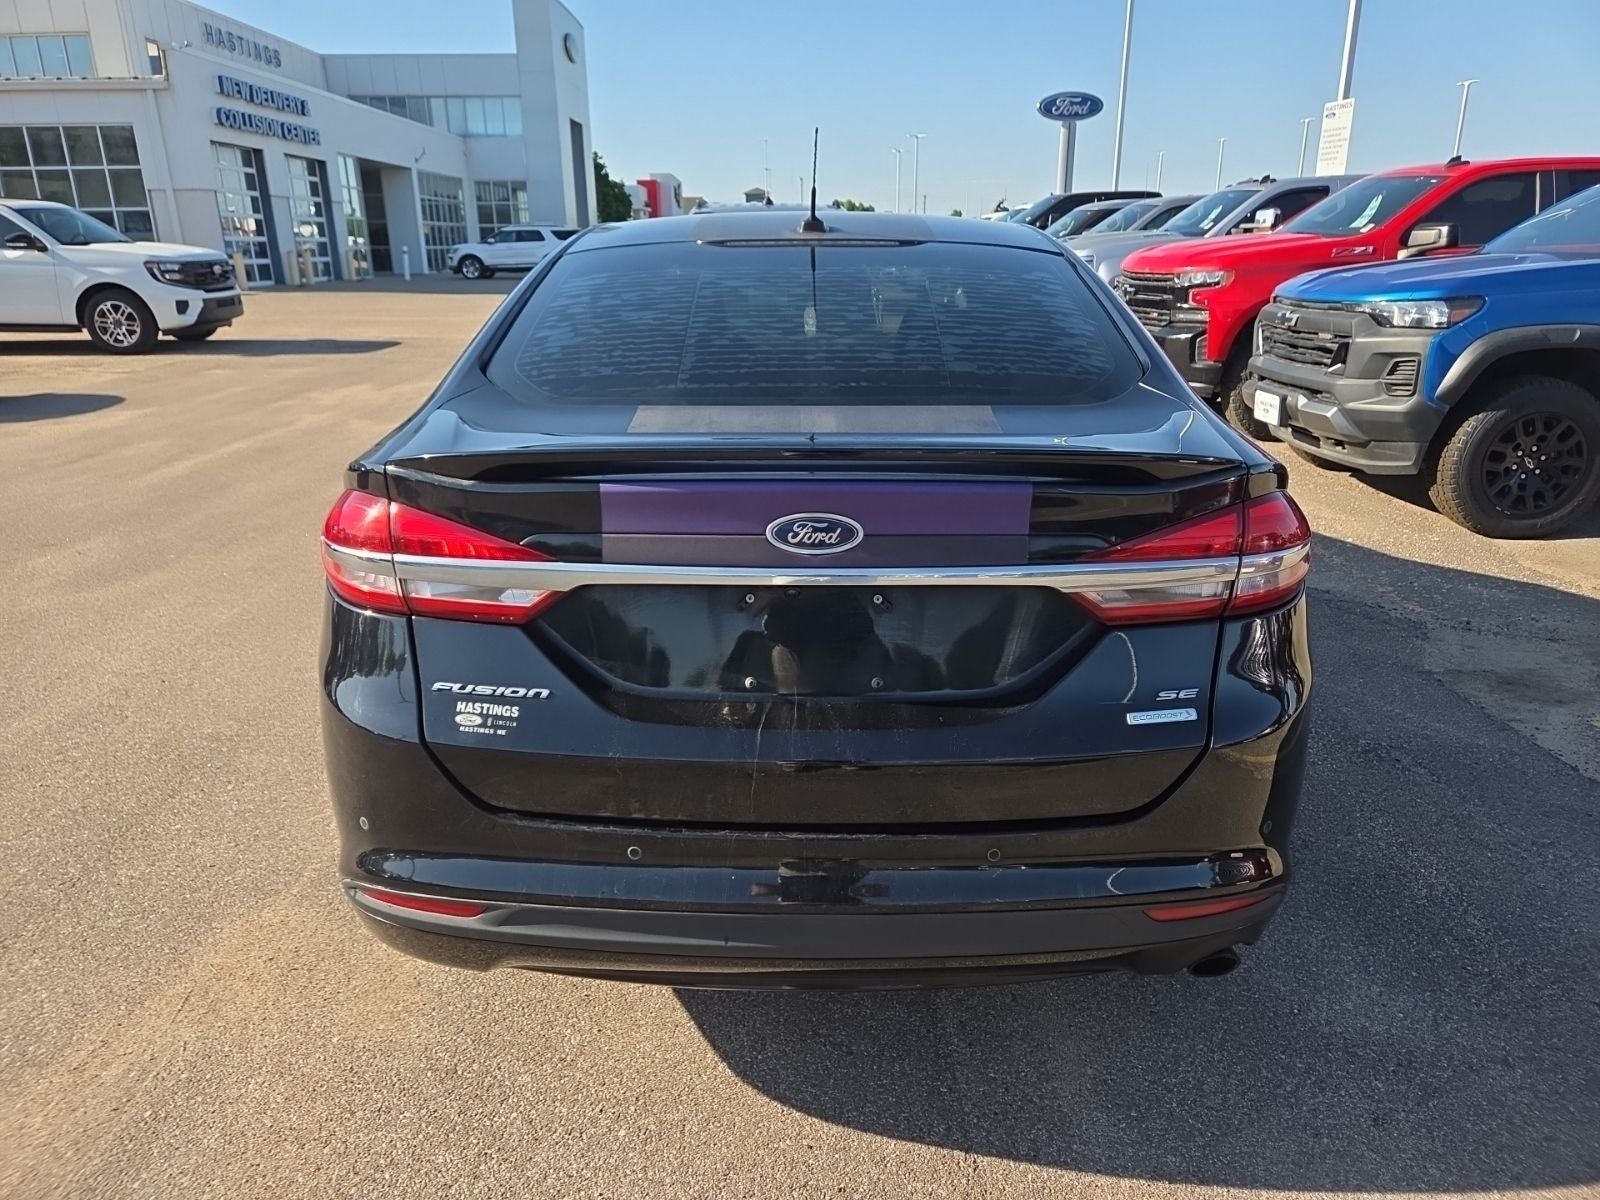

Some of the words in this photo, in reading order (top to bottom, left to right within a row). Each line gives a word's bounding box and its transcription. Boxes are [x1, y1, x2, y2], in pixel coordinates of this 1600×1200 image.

[203, 22, 282, 68] HASTINGS
[218, 75, 252, 103] NEW
[252, 84, 304, 116] DELIVERY
[304, 99, 312, 118] &
[1052, 97, 1091, 116] Ford
[1325, 101, 1353, 112] HASTINGS
[216, 106, 281, 139] COLLISION
[281, 121, 321, 146] CENTER
[788, 521, 841, 544] Ford
[431, 681, 550, 699] FUSION
[1156, 688, 1200, 701] SE
[456, 701, 520, 718] HASTINGS
[459, 725, 494, 735] HASTINGS
[493, 719, 517, 727] LINCOLN
